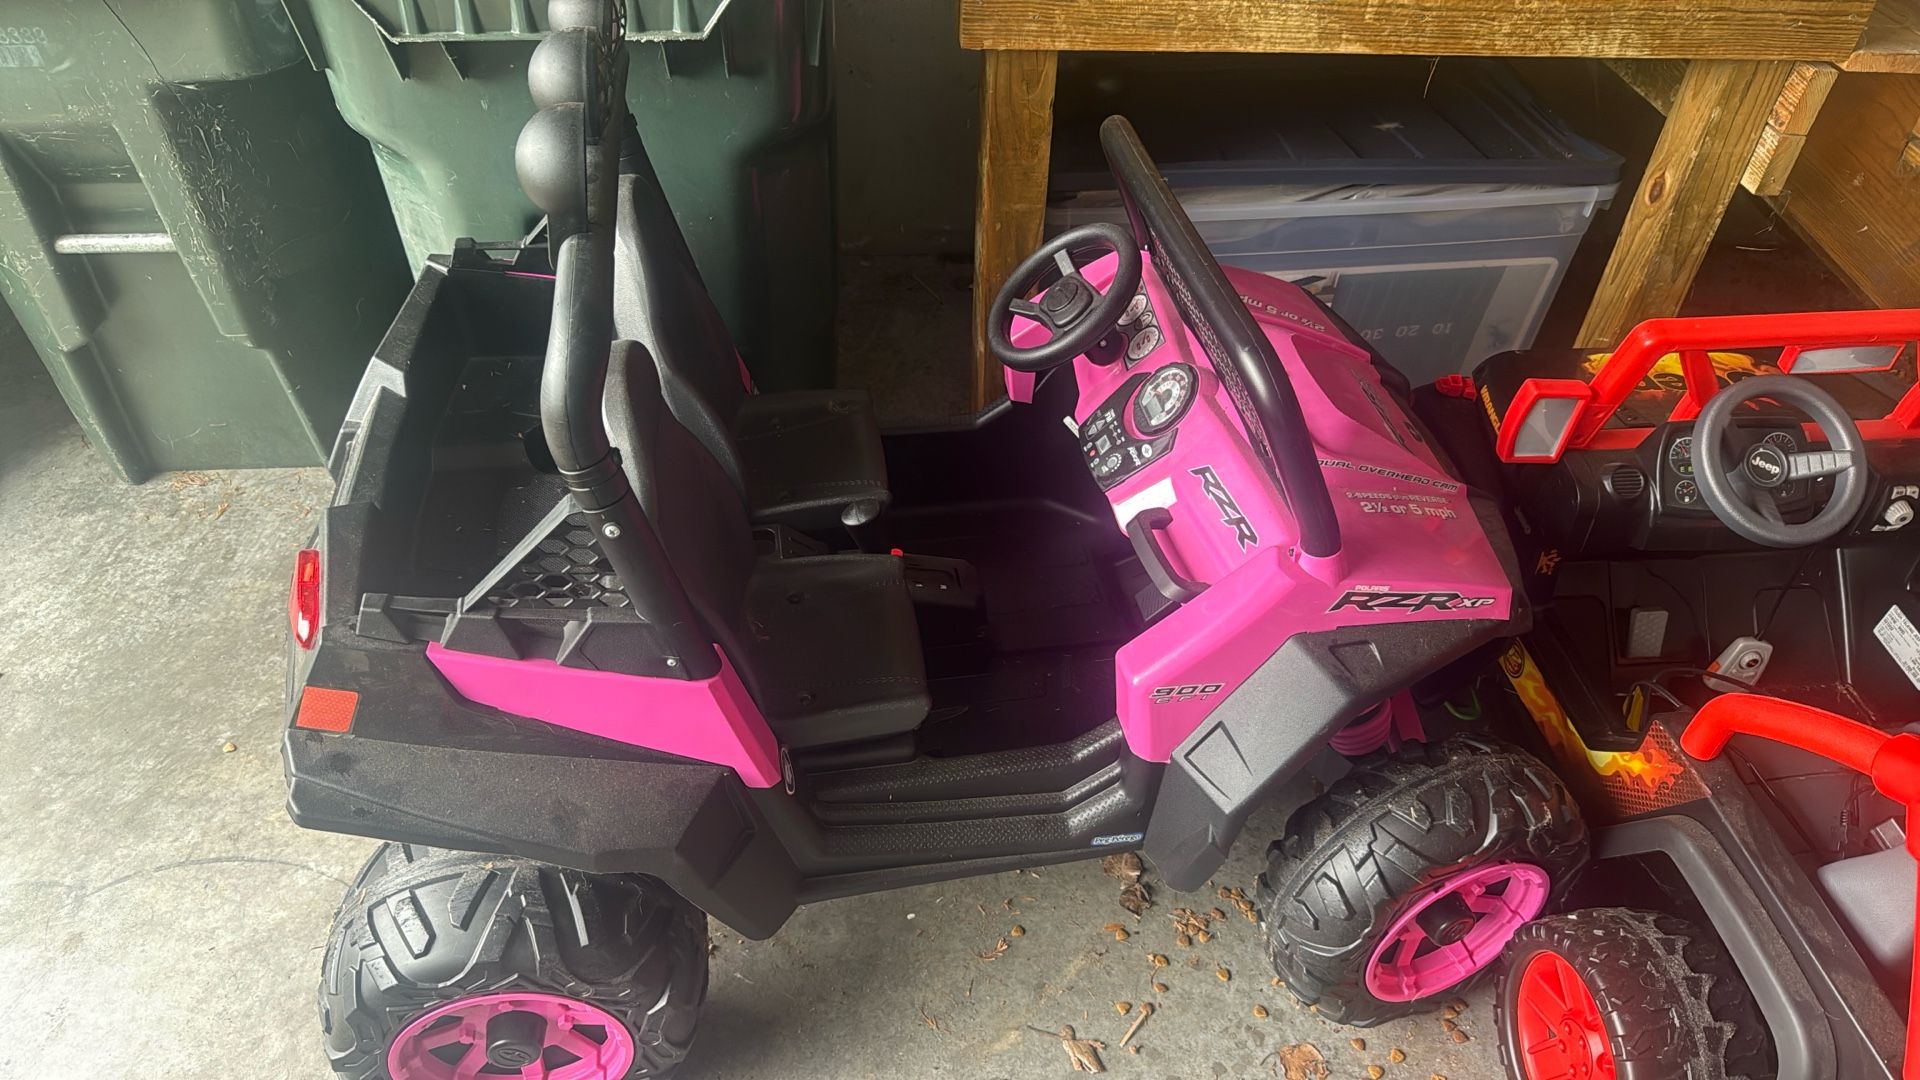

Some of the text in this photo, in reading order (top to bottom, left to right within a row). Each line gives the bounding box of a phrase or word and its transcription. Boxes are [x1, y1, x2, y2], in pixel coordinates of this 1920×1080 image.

[1239, 295, 1262, 308] mp
[1267, 305, 1277, 314] 5
[1281, 311, 1298, 320] or
[1395, 325, 1420, 337] 20
[1752, 456, 1780, 474] Jeep
[1358, 464, 1431, 485] OVERHEAD
[1432, 480, 1459, 493] CAM
[1187, 464, 1259, 554] RZR
[1390, 504, 1407, 514] or
[1408, 503, 1423, 515] 5
[1424, 506, 1457, 519] mph
[1354, 584, 1390, 592] POLARIS
[1325, 590, 1497, 615] RZR XP
[1149, 683, 1225, 698] 900
